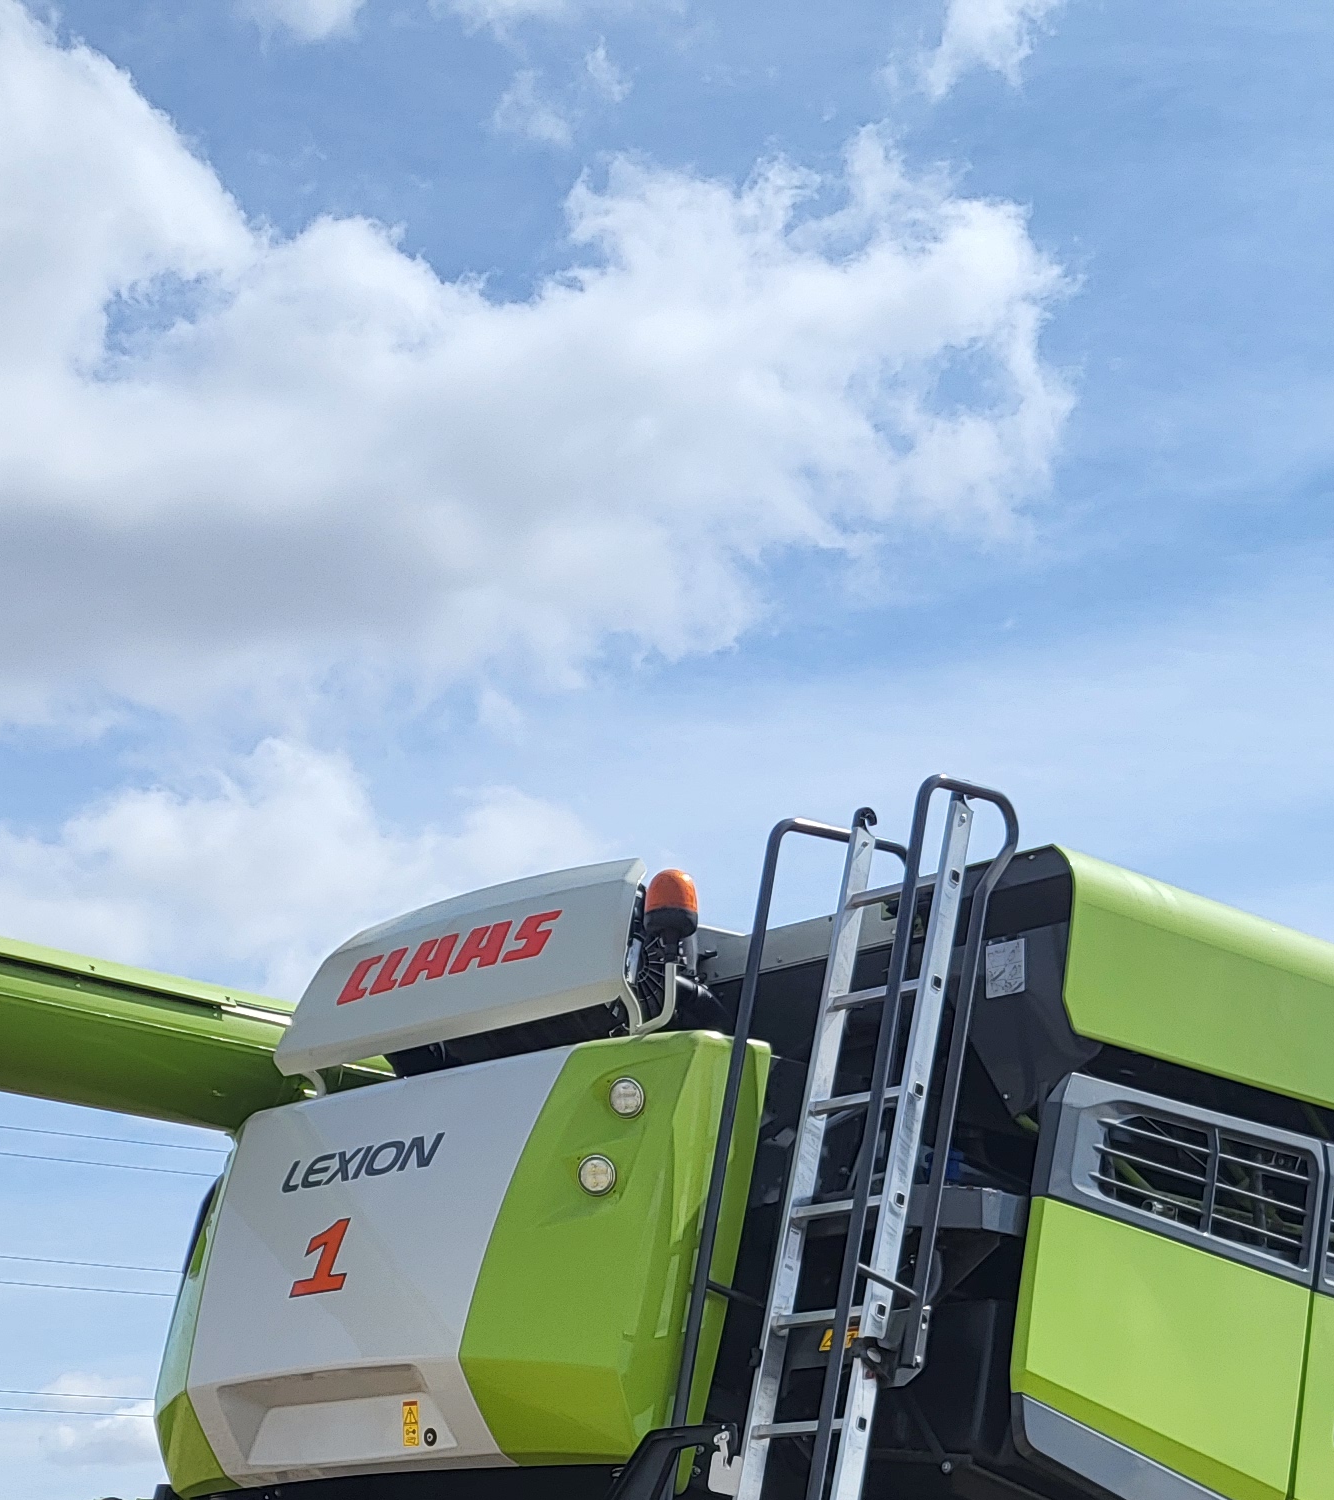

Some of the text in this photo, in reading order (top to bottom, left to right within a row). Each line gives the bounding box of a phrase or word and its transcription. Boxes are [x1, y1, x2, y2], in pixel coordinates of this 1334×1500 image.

[337, 909, 563, 1006] CLAAS
[282, 1132, 446, 1193] LEXION
[288, 1217, 352, 1299] 1
